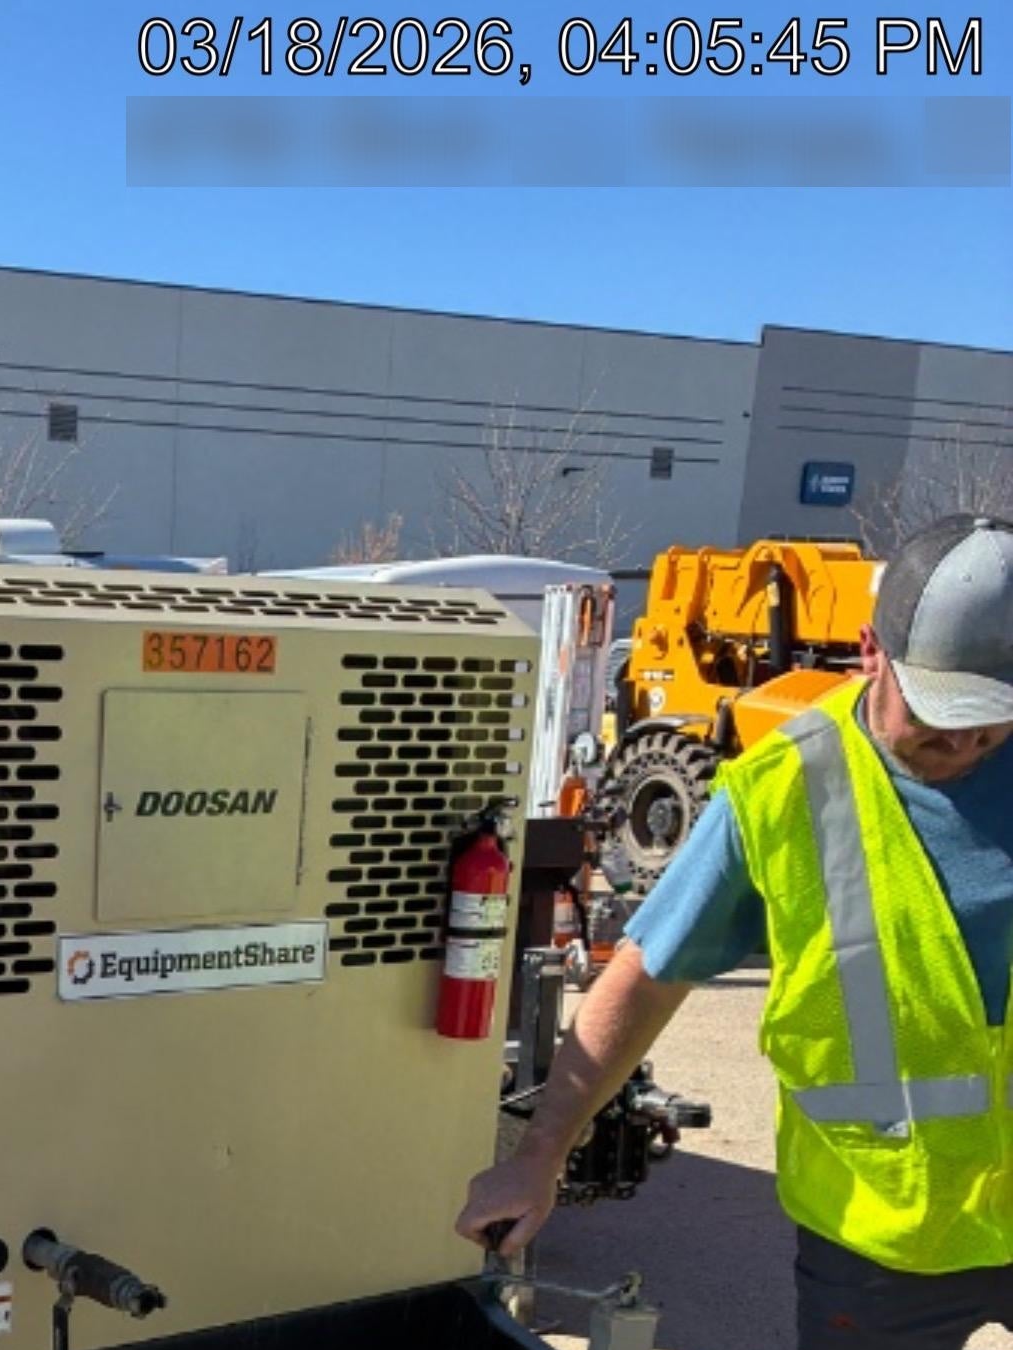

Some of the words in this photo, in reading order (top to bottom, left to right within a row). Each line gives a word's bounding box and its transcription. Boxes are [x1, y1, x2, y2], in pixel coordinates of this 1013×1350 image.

[145, 632, 275, 673] 357162
[135, 788, 278, 818] DOOSAN
[99, 942, 317, 983] EquipmentShare
